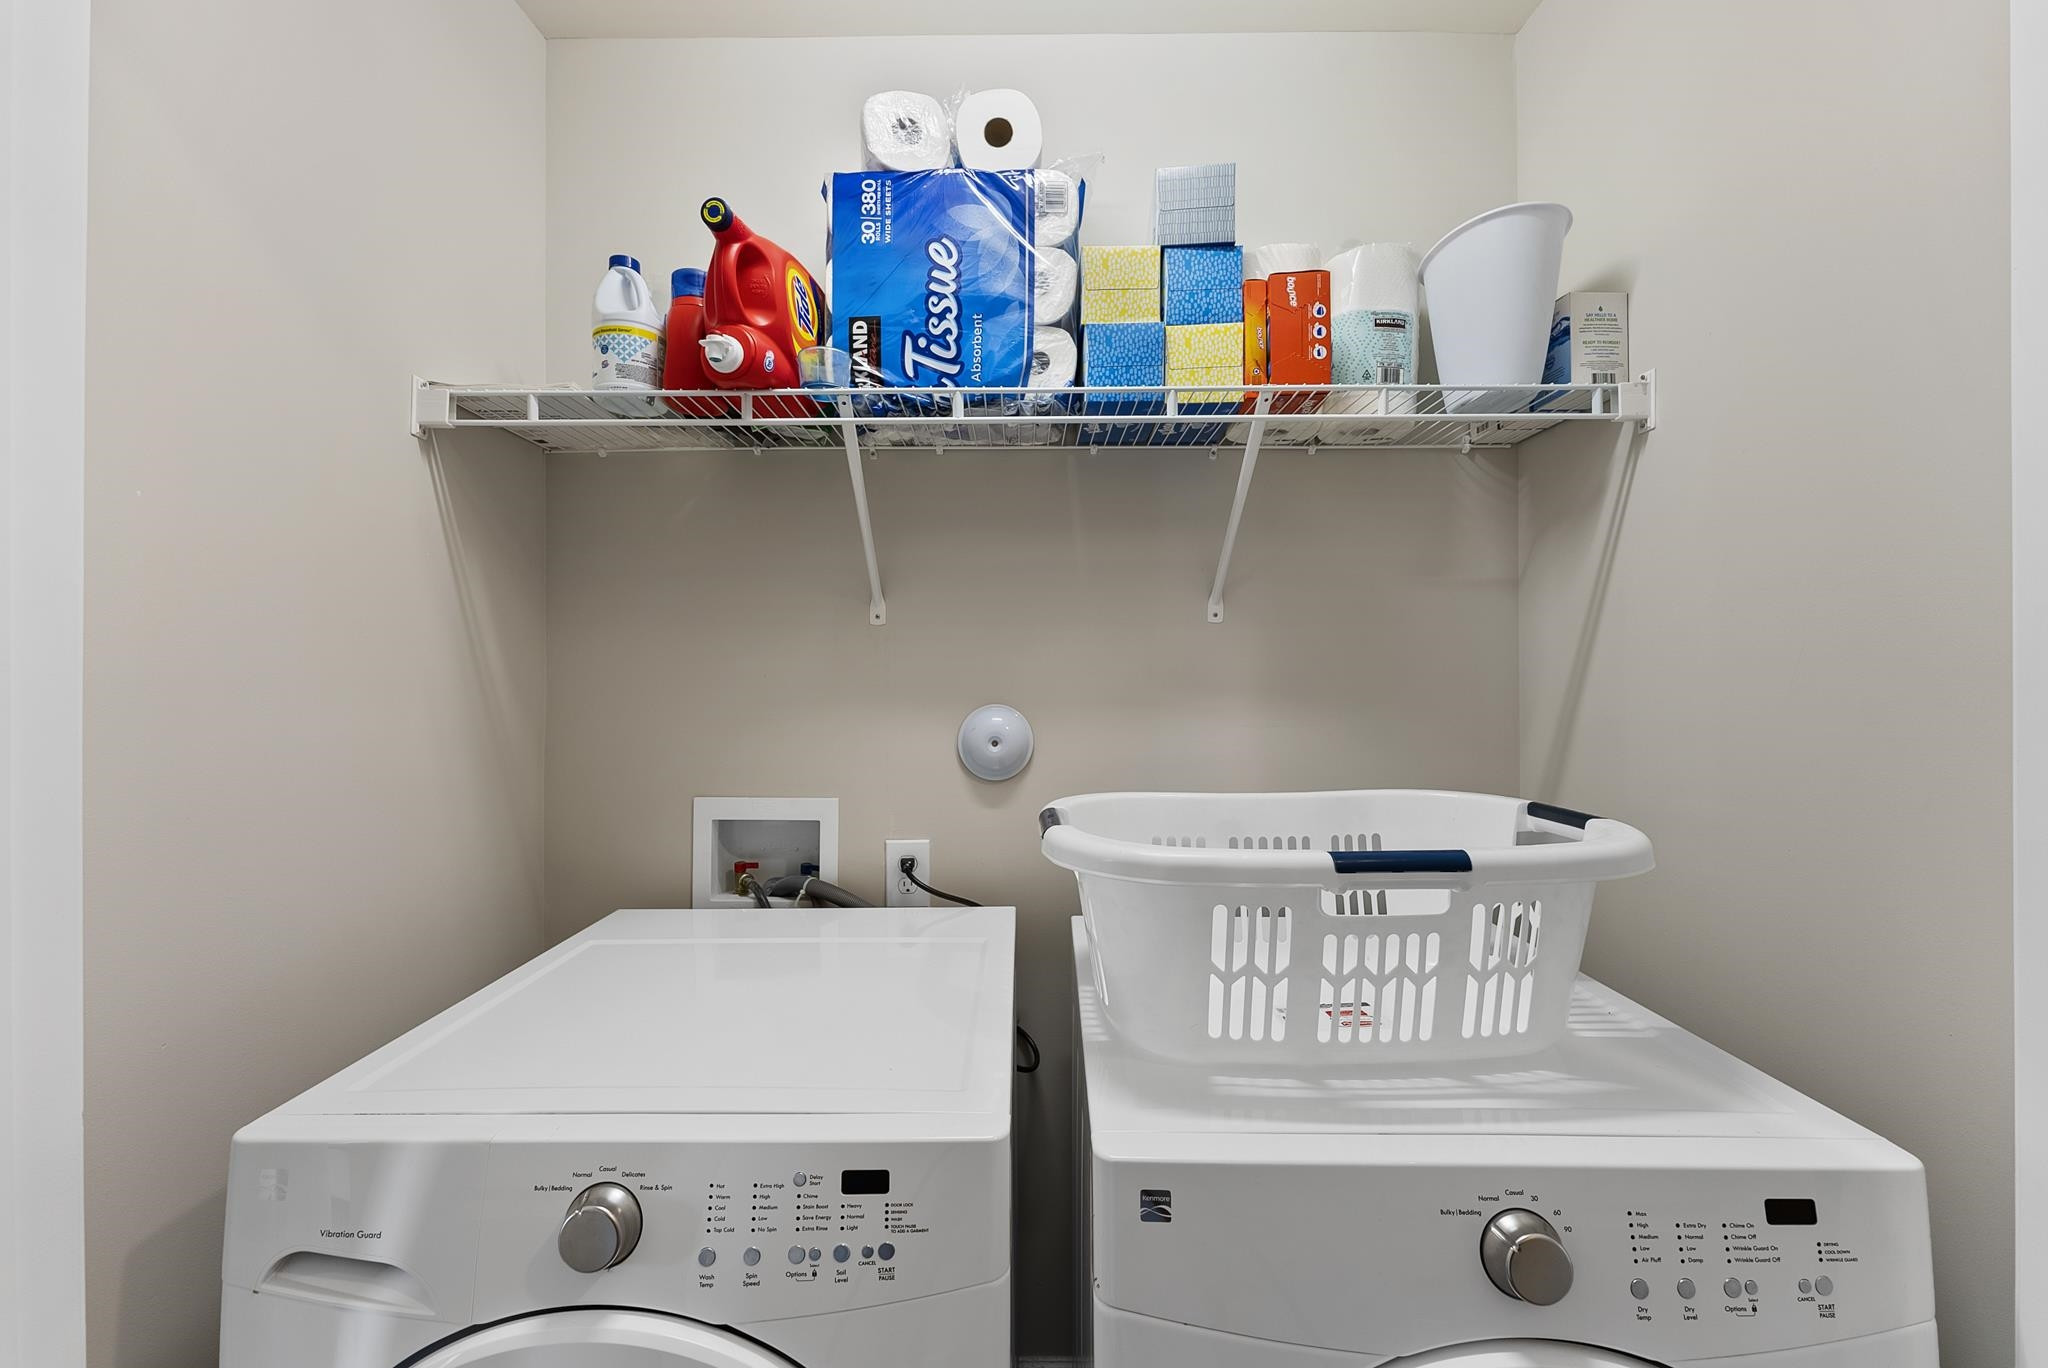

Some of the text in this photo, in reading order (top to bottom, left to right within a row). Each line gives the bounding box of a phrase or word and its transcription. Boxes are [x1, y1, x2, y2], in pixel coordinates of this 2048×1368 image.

[860, 179, 876, 244] 30 380
[792, 274, 816, 339] Tide
[904, 237, 961, 378] Tissue
[1286, 276, 1298, 308] bounce
[970, 314, 983, 382] Absorbent
[320, 1230, 382, 1239] Vibration Guard
